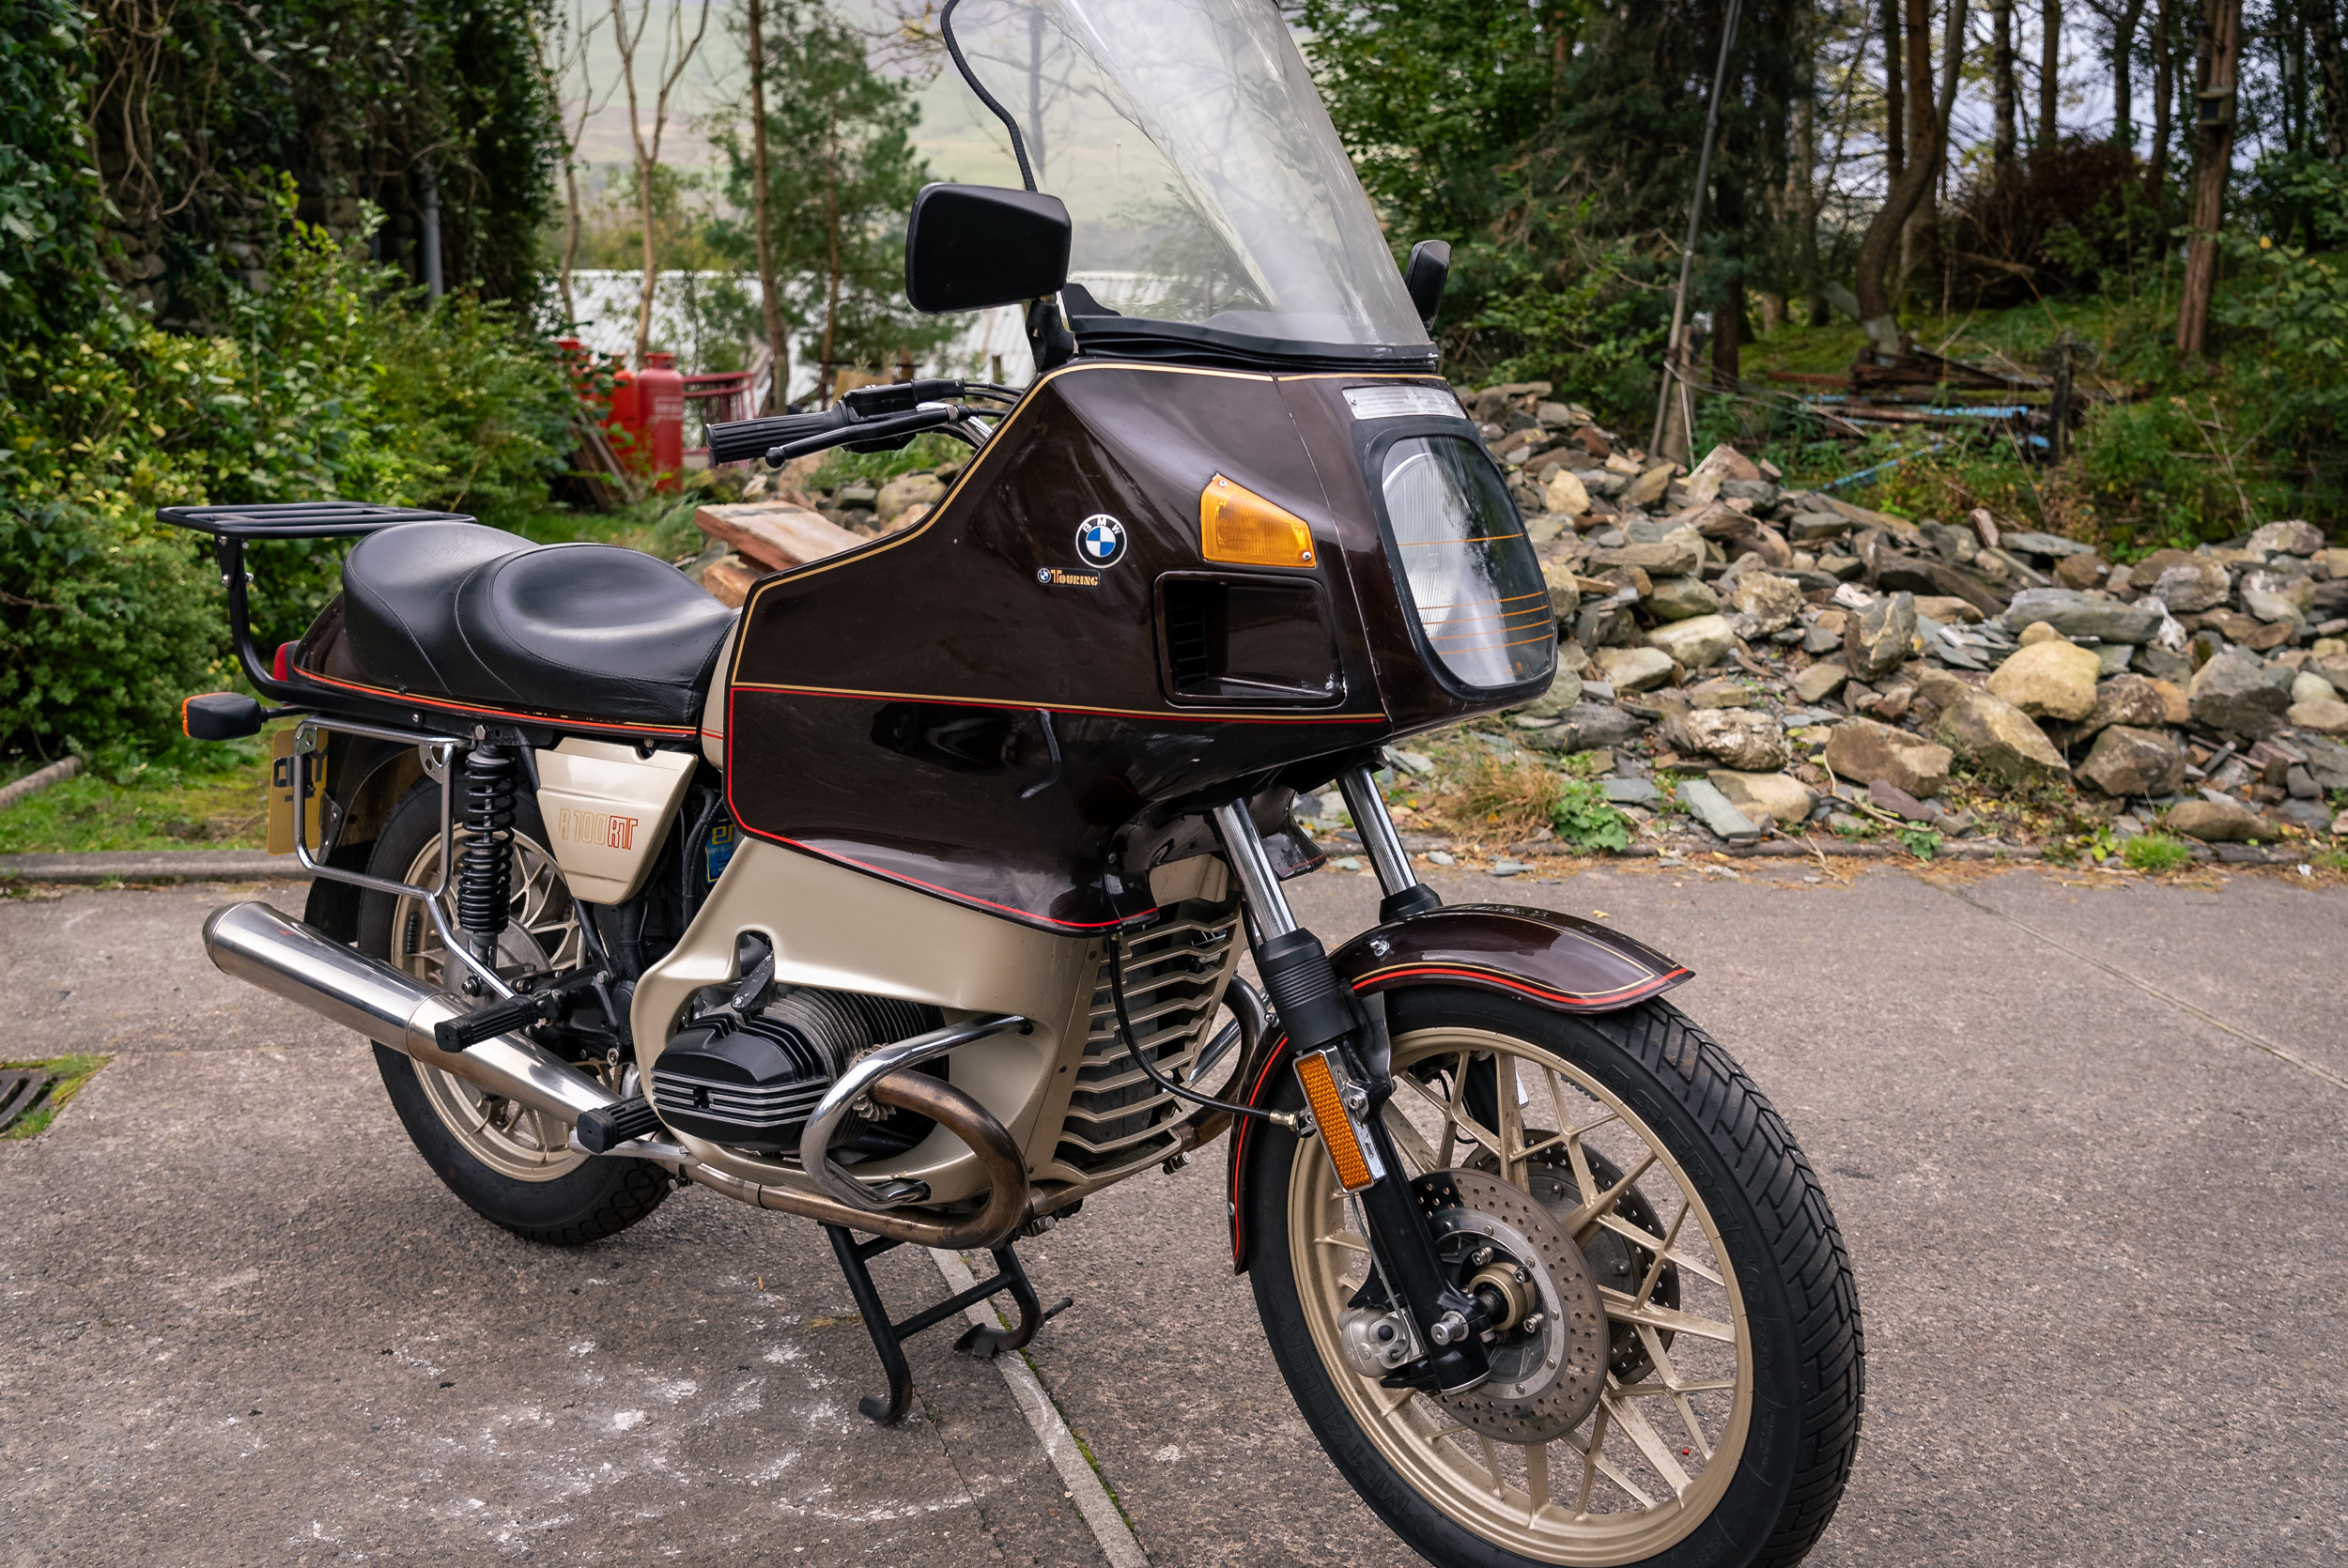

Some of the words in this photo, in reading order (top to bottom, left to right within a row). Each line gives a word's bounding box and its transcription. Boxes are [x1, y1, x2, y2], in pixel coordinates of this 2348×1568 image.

[1082, 517, 1122, 535] BMW
[1573, 1039, 1768, 1304] LASERTEC
[1277, 1320, 1411, 1518] METZELER
